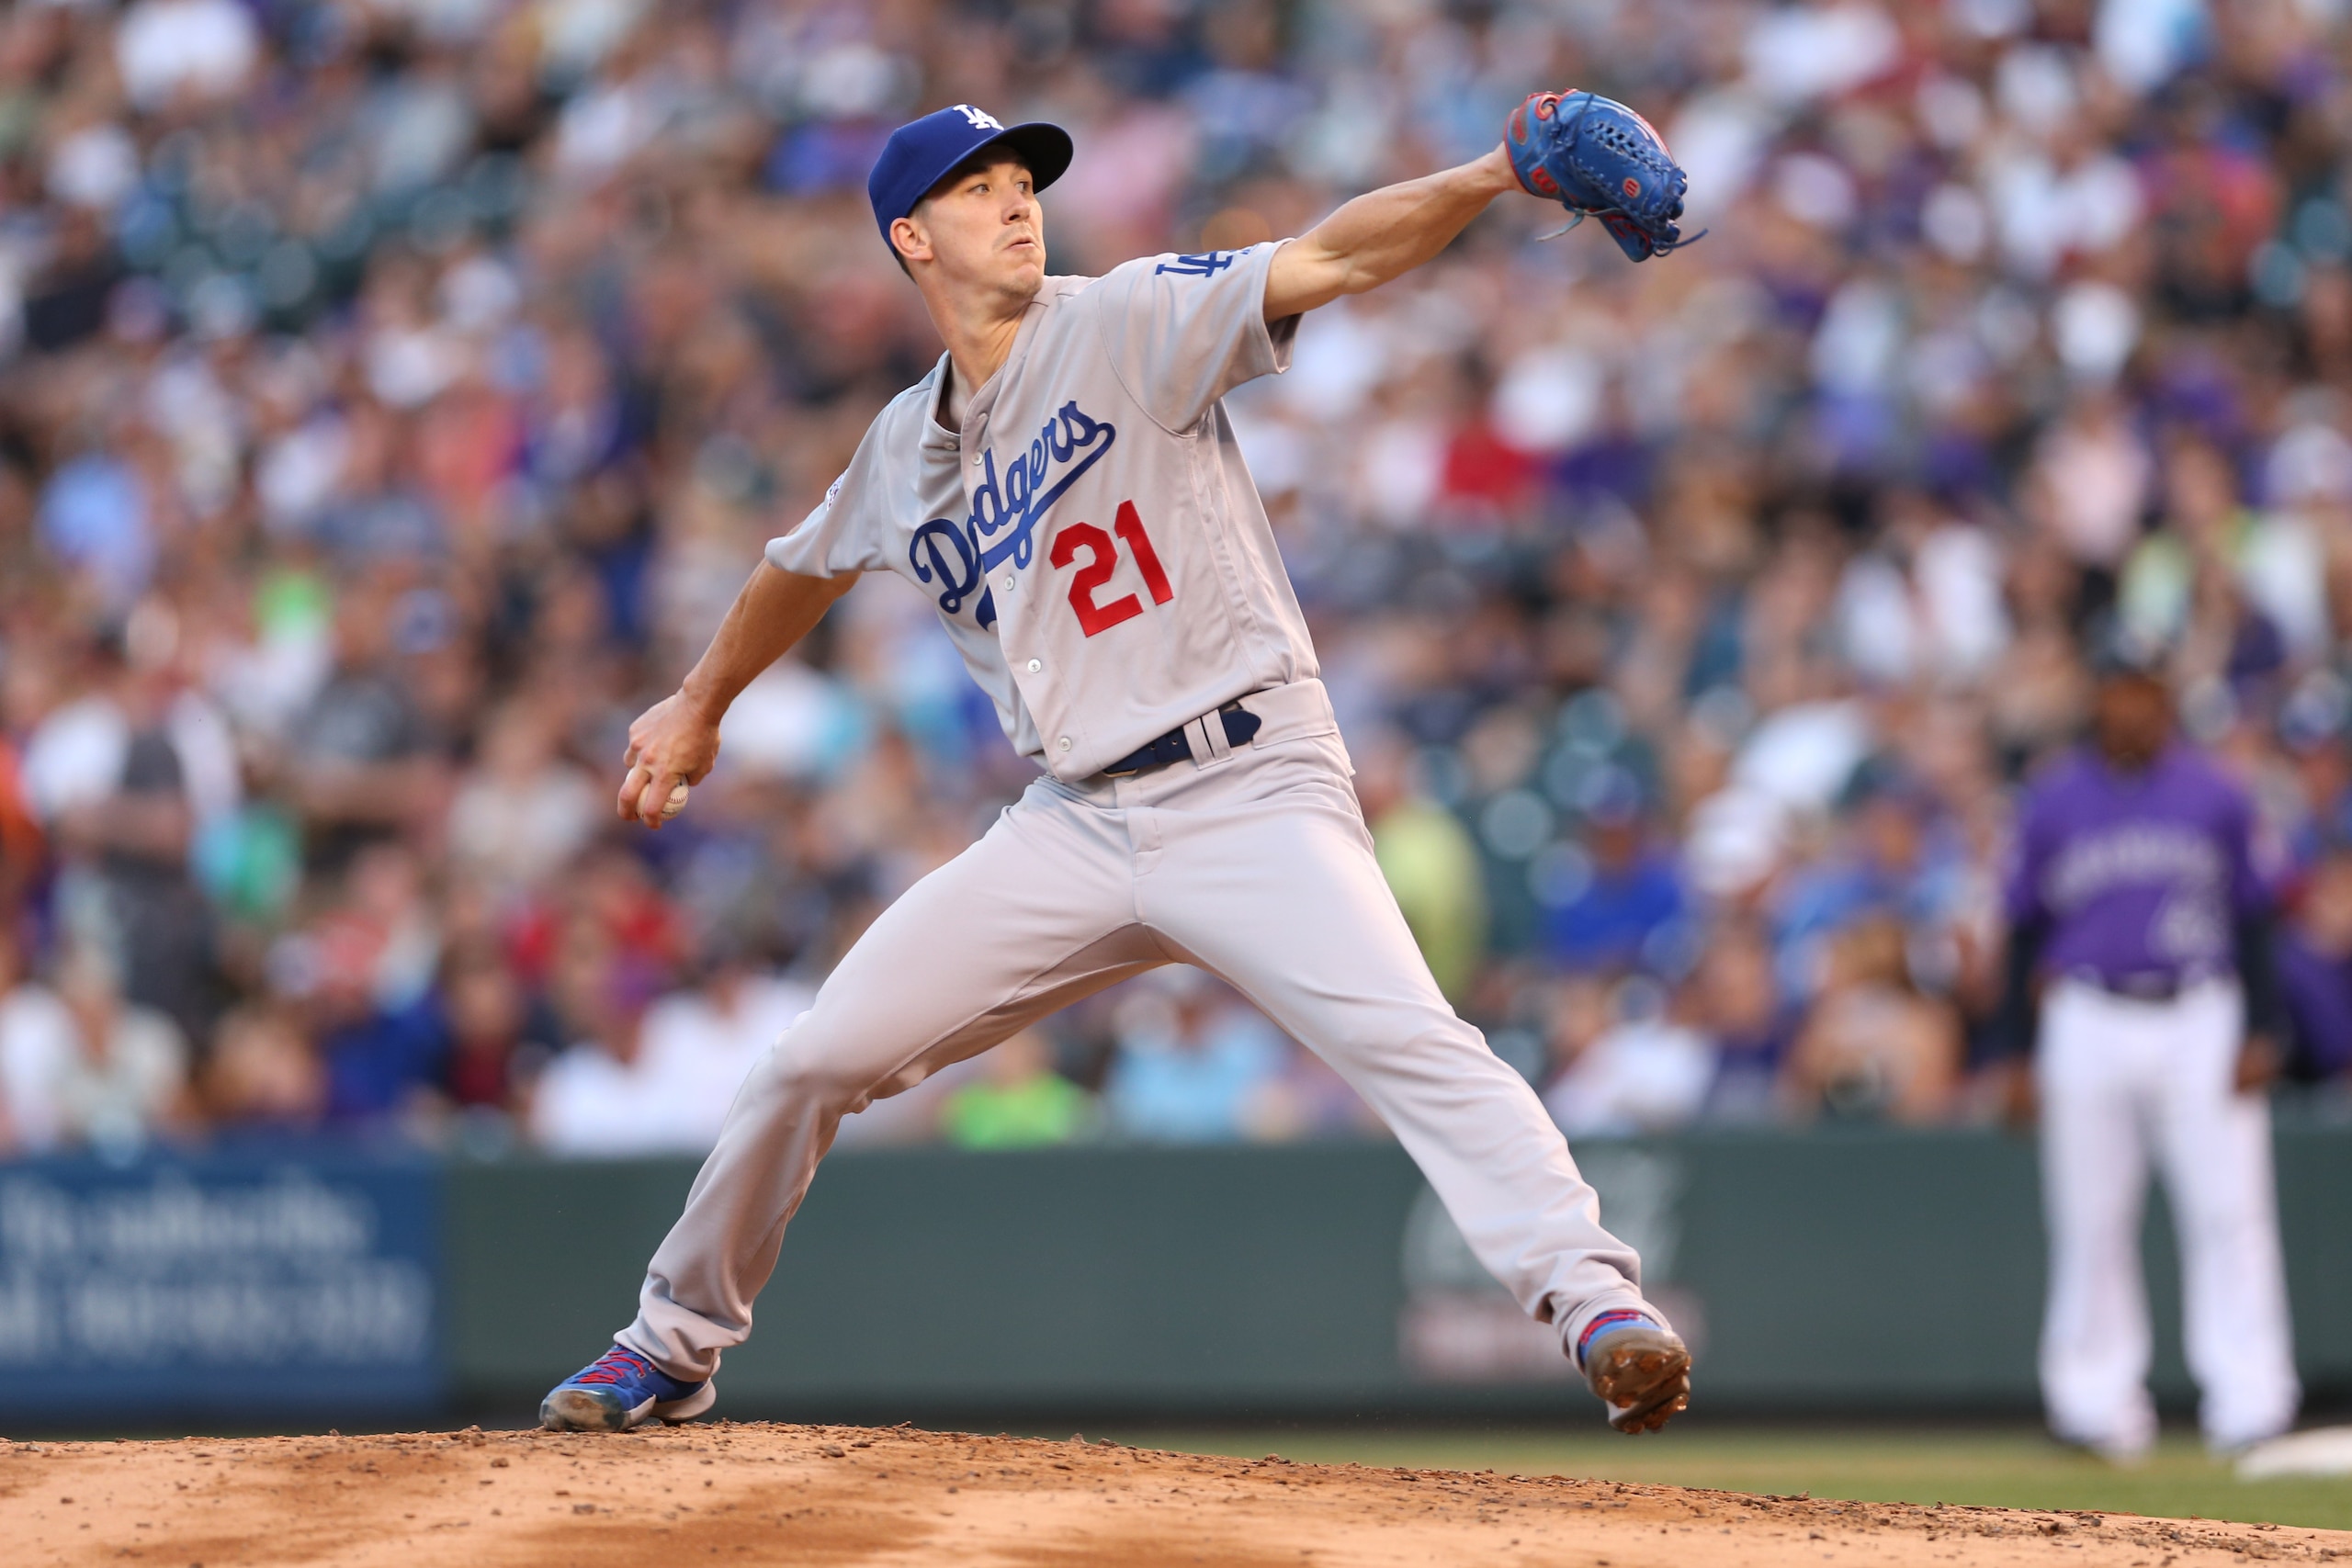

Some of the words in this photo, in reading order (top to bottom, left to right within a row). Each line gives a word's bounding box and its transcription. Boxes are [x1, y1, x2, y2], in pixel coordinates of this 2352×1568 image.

[953, 104, 1004, 131] LA
[1155, 251, 1234, 277] LA
[910, 400, 1115, 631] Dodgers
[1049, 499, 1173, 637] 21
